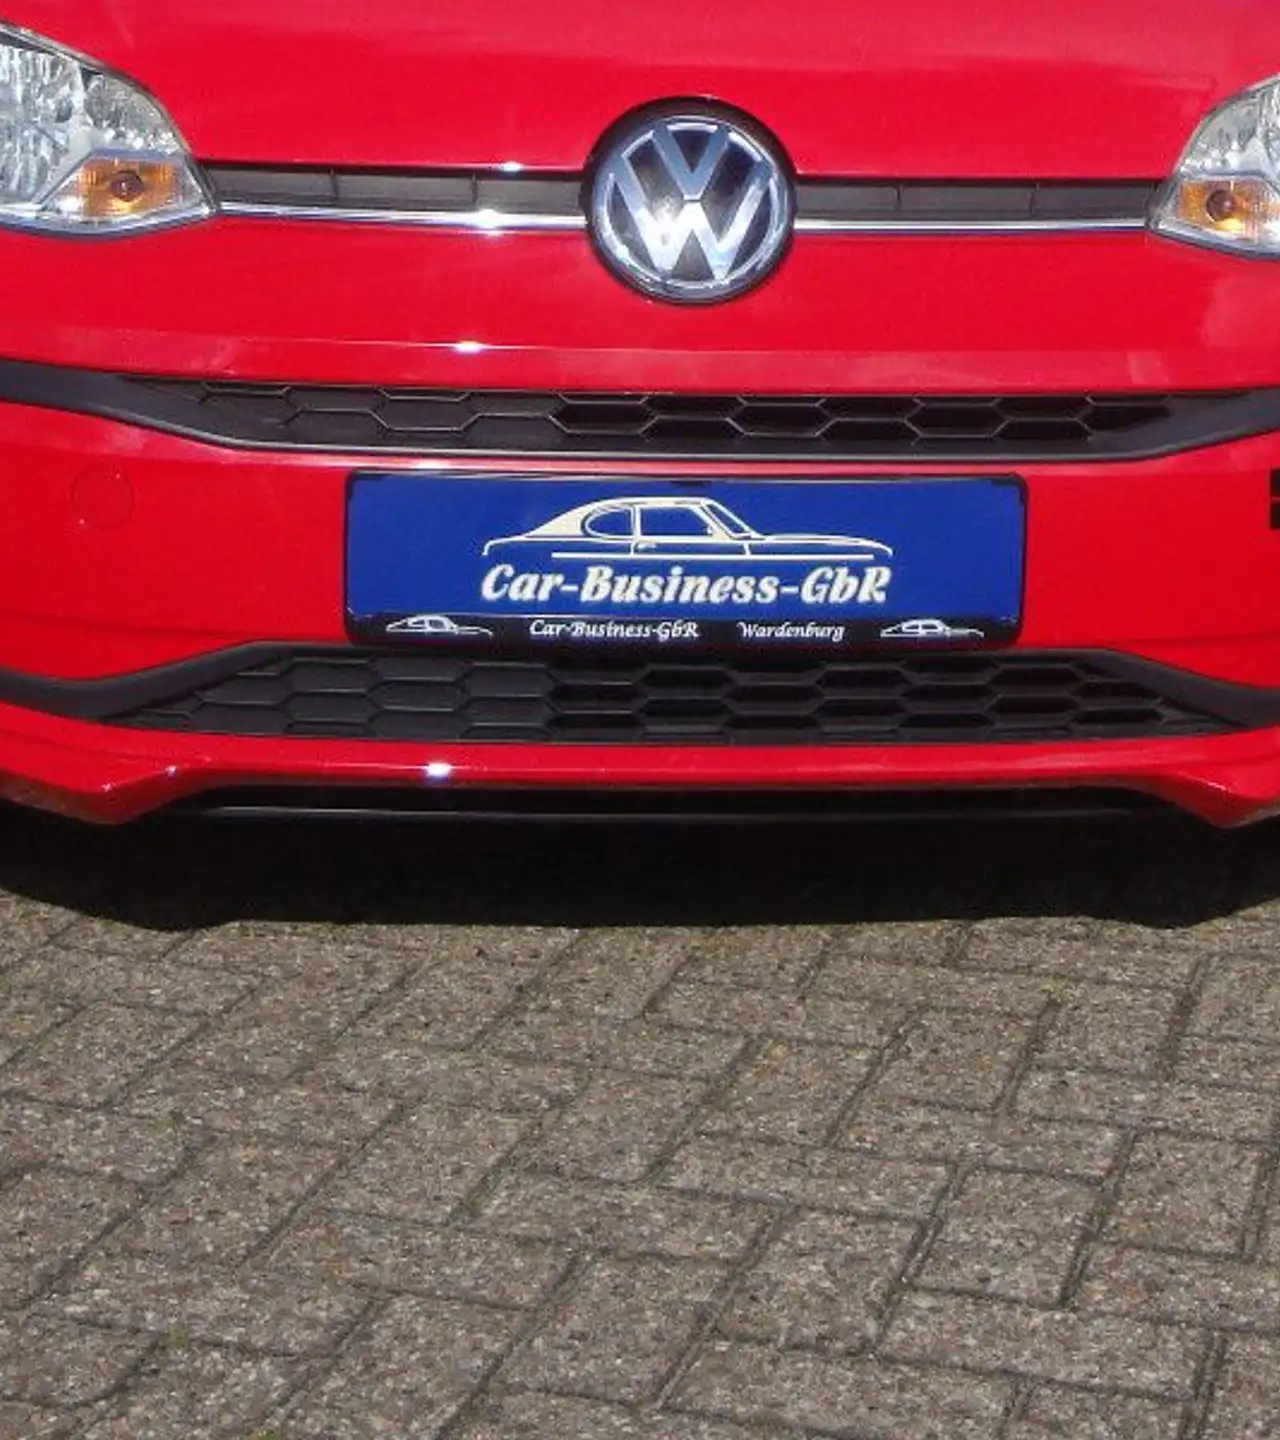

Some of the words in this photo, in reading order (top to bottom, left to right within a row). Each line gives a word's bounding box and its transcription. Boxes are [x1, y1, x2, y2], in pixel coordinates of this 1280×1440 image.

[602, 120, 778, 287] VW
[481, 563, 892, 604] Car-Business-GbR
[529, 619, 699, 642] Car-Business-GbR
[737, 621, 846, 643] Wardenburg
